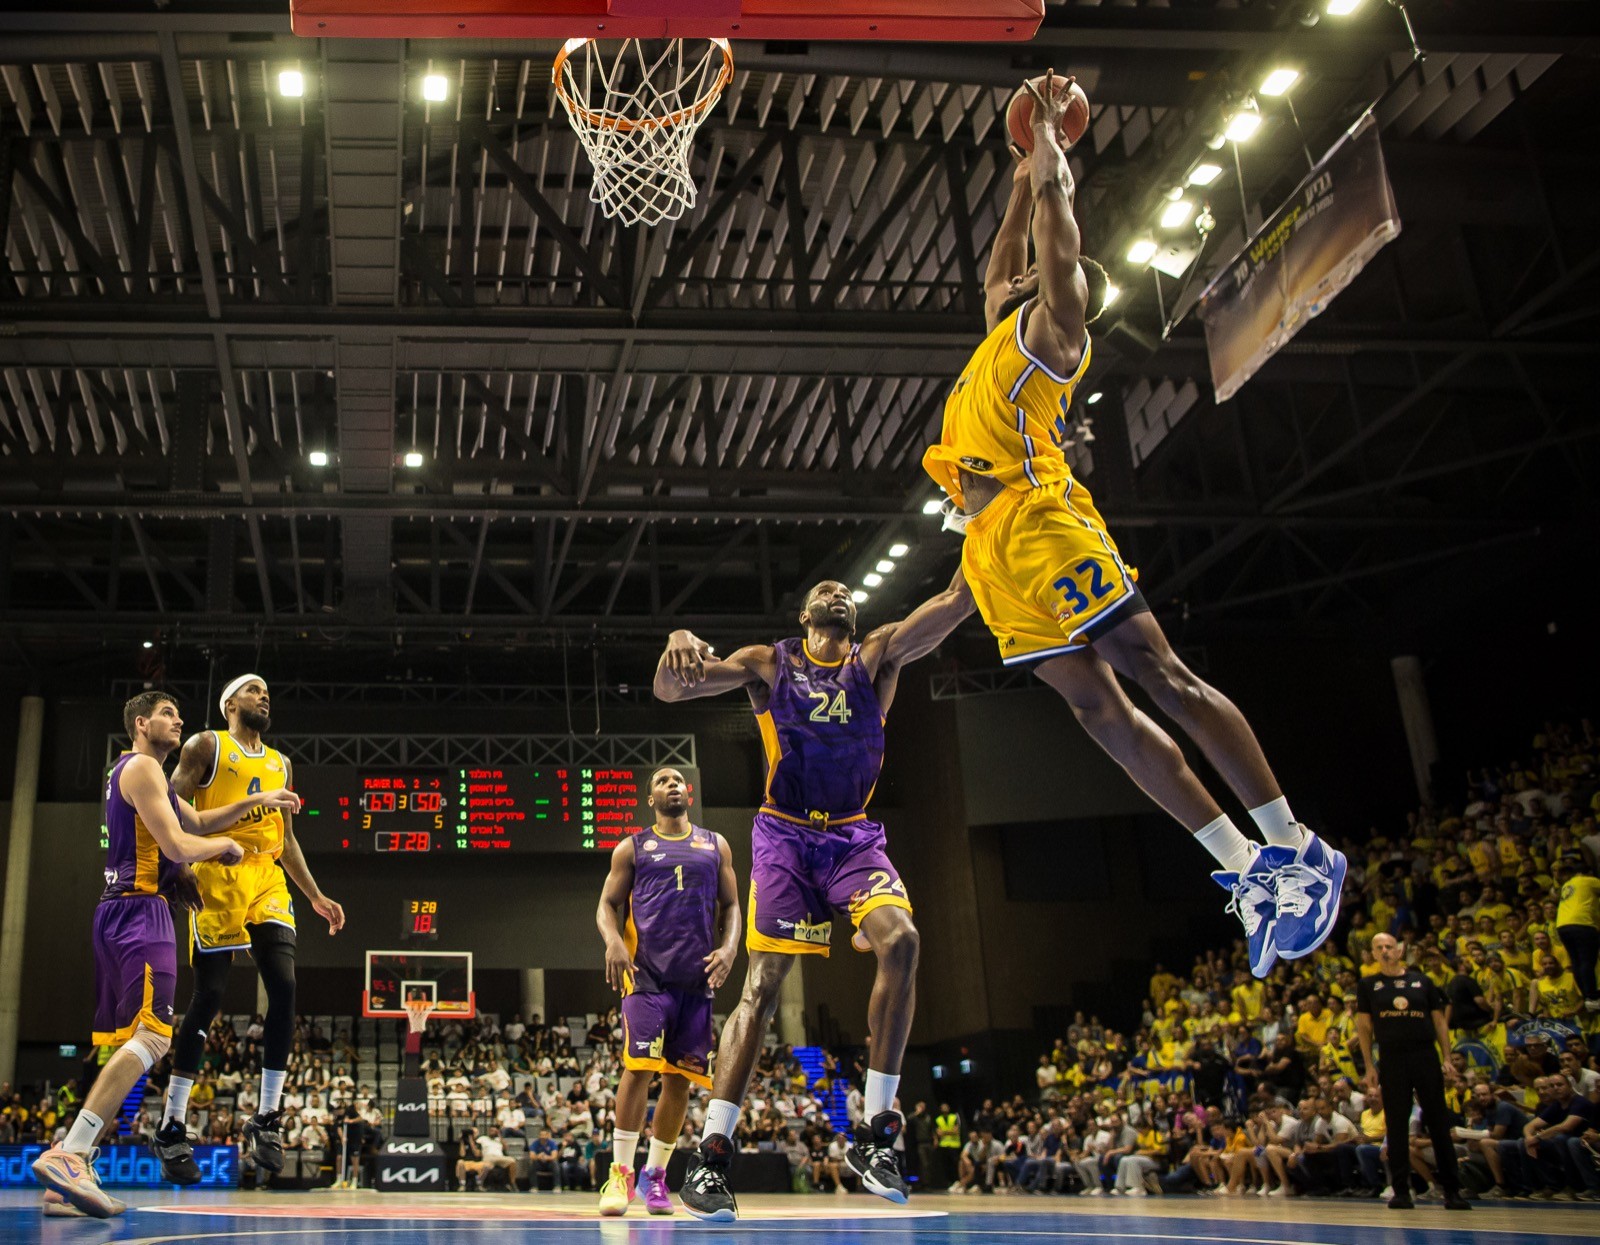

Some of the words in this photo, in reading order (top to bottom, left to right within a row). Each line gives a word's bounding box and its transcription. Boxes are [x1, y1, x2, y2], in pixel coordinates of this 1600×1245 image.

[1054, 558, 1115, 613] 32
[808, 690, 852, 724] 24
[459, 769, 466, 779] 1
[581, 769, 593, 779] 14
[247, 776, 261, 796] 4
[364, 778, 391, 789] PLAYER
[412, 778, 421, 789] 2
[459, 783, 466, 793] 2
[581, 783, 593, 793] 20
[371, 792, 395, 812] 69
[398, 795, 408, 810] 3
[417, 792, 441, 812] 50
[459, 797, 467, 807] 4
[362, 814, 372, 829] 3
[434, 814, 444, 829] 5
[582, 811, 594, 821] 30
[456, 825, 468, 835] 10
[456, 839, 468, 849] 12
[674, 865, 685, 891] 1
[867, 871, 910, 898] 24
[413, 914, 433, 934] 18
[387, 1142, 435, 1154] KIA
[382, 1167, 440, 1183] KIA
